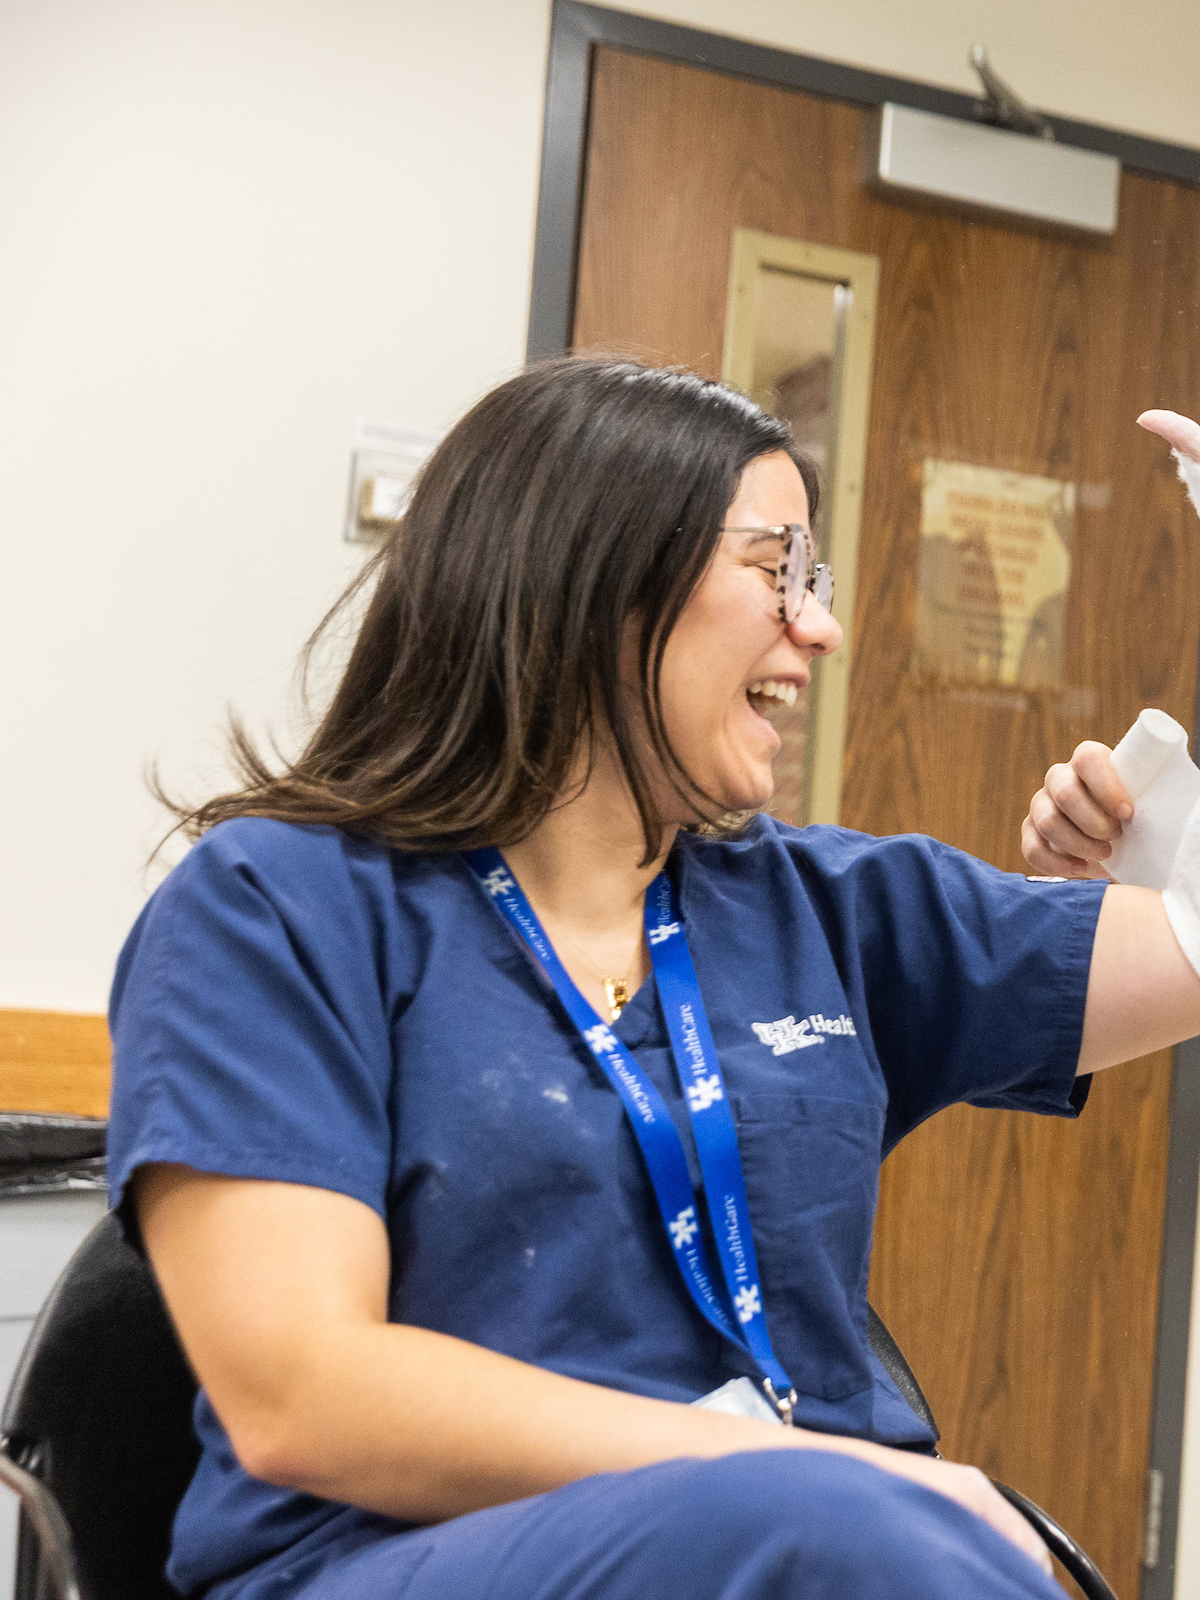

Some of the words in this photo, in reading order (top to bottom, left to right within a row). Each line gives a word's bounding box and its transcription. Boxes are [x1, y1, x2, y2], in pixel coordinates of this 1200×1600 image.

[679, 1001, 708, 1077] HealthCare
[607, 1053, 655, 1123] HealthCare
[724, 1194, 749, 1283] HealthCare
